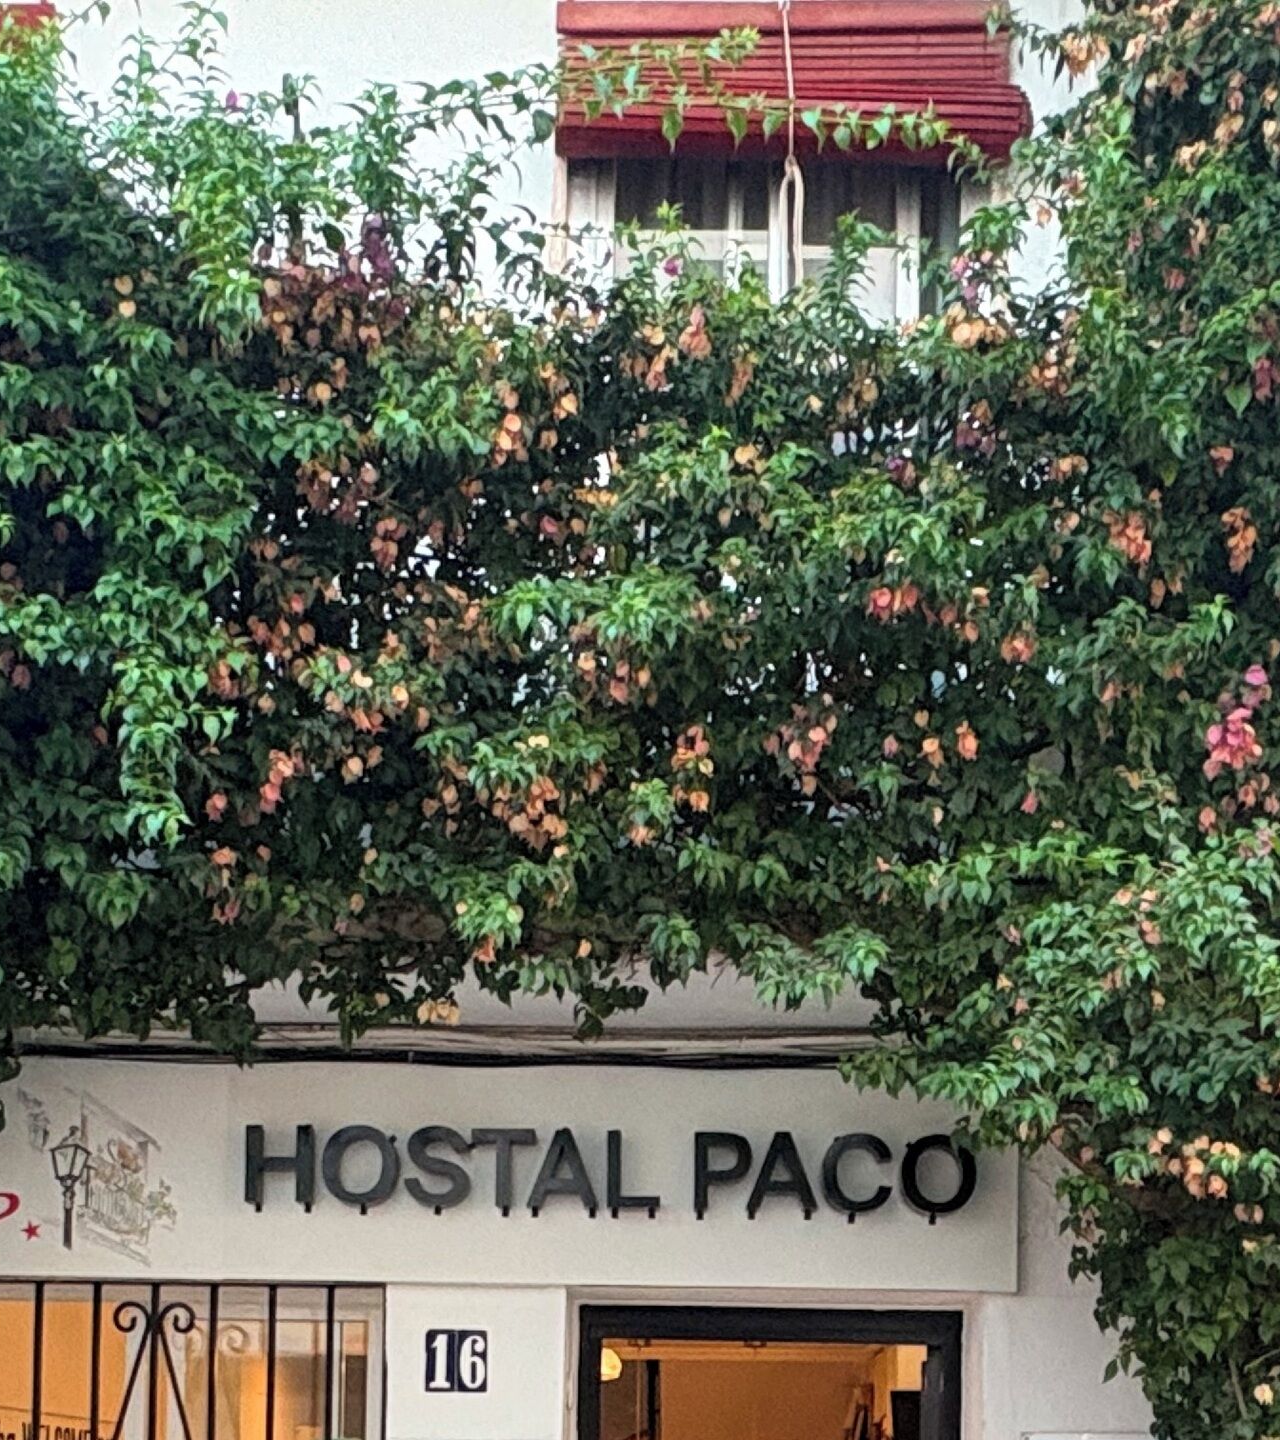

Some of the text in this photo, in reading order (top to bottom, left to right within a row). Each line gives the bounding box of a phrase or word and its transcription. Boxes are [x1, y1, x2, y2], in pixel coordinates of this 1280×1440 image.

[244, 1123, 978, 1219] HOSTAL PACO
[429, 1333, 486, 1390] 16
